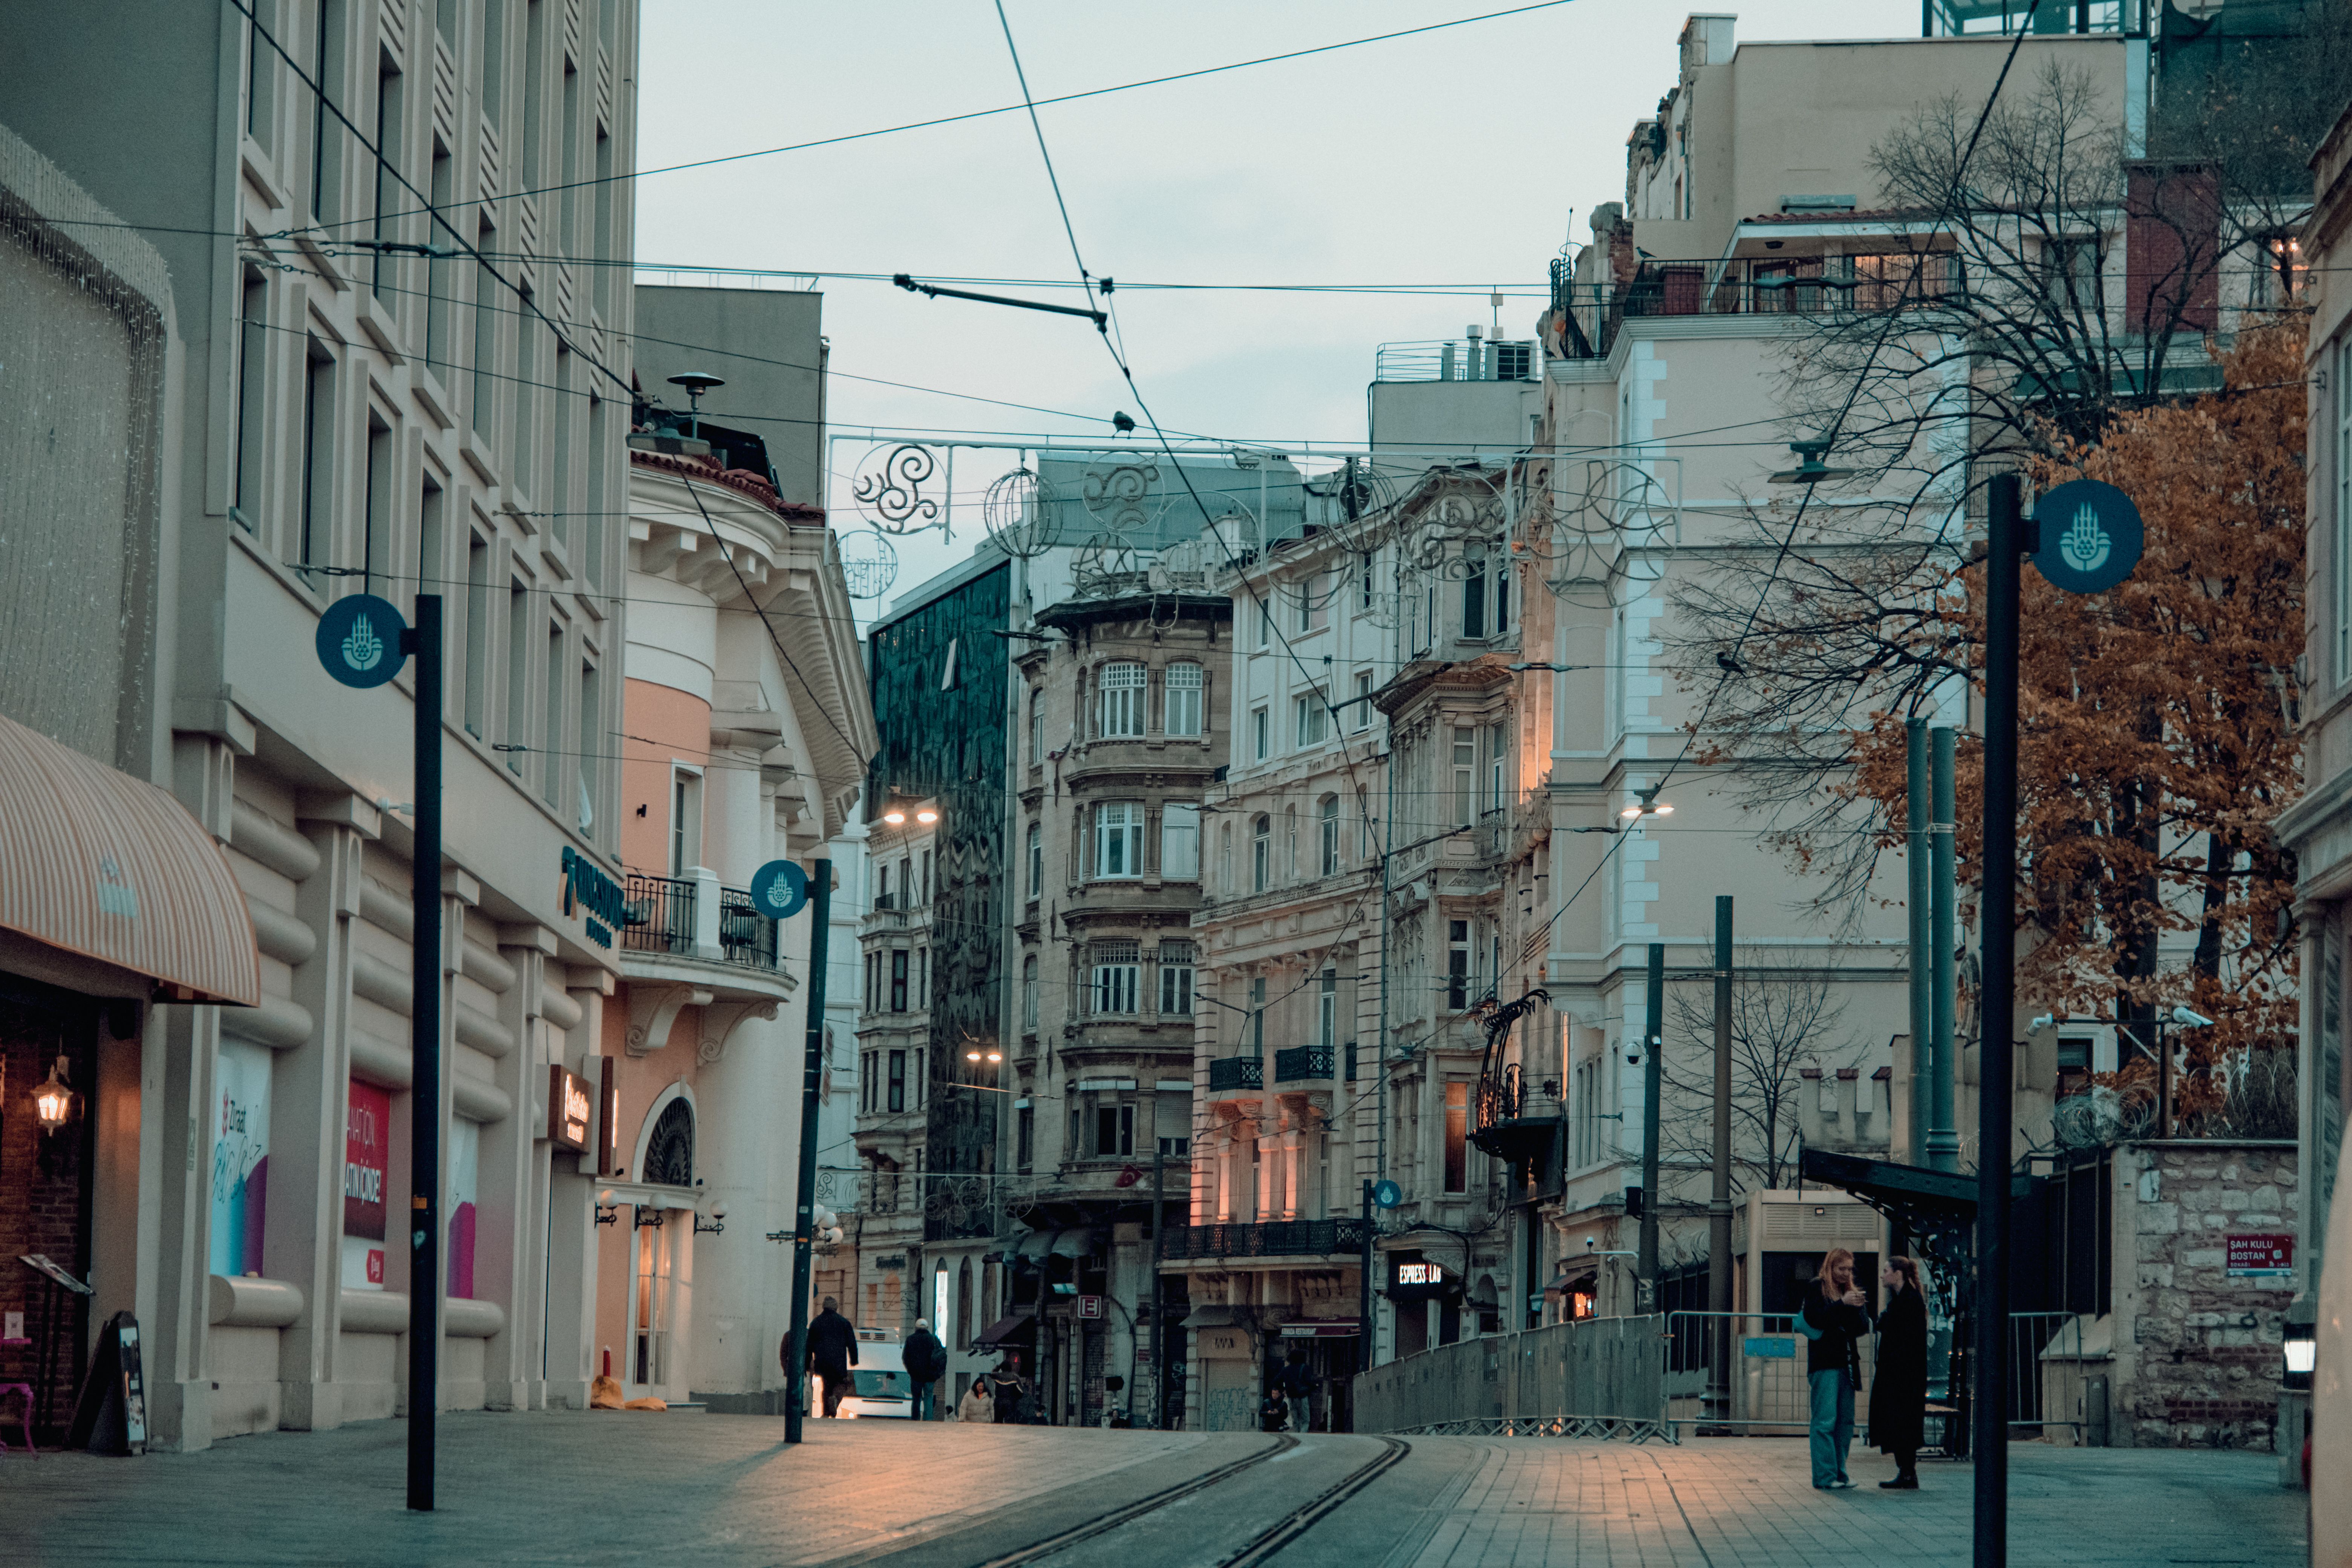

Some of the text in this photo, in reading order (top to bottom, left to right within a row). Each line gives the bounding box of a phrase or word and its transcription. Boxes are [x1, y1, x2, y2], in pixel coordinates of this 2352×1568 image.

[229, 1100, 246, 1134] Ziraat
[2230, 1240, 2273, 1250] ŞAH KULU
[2230, 1251, 2265, 1260] BOSTAN
